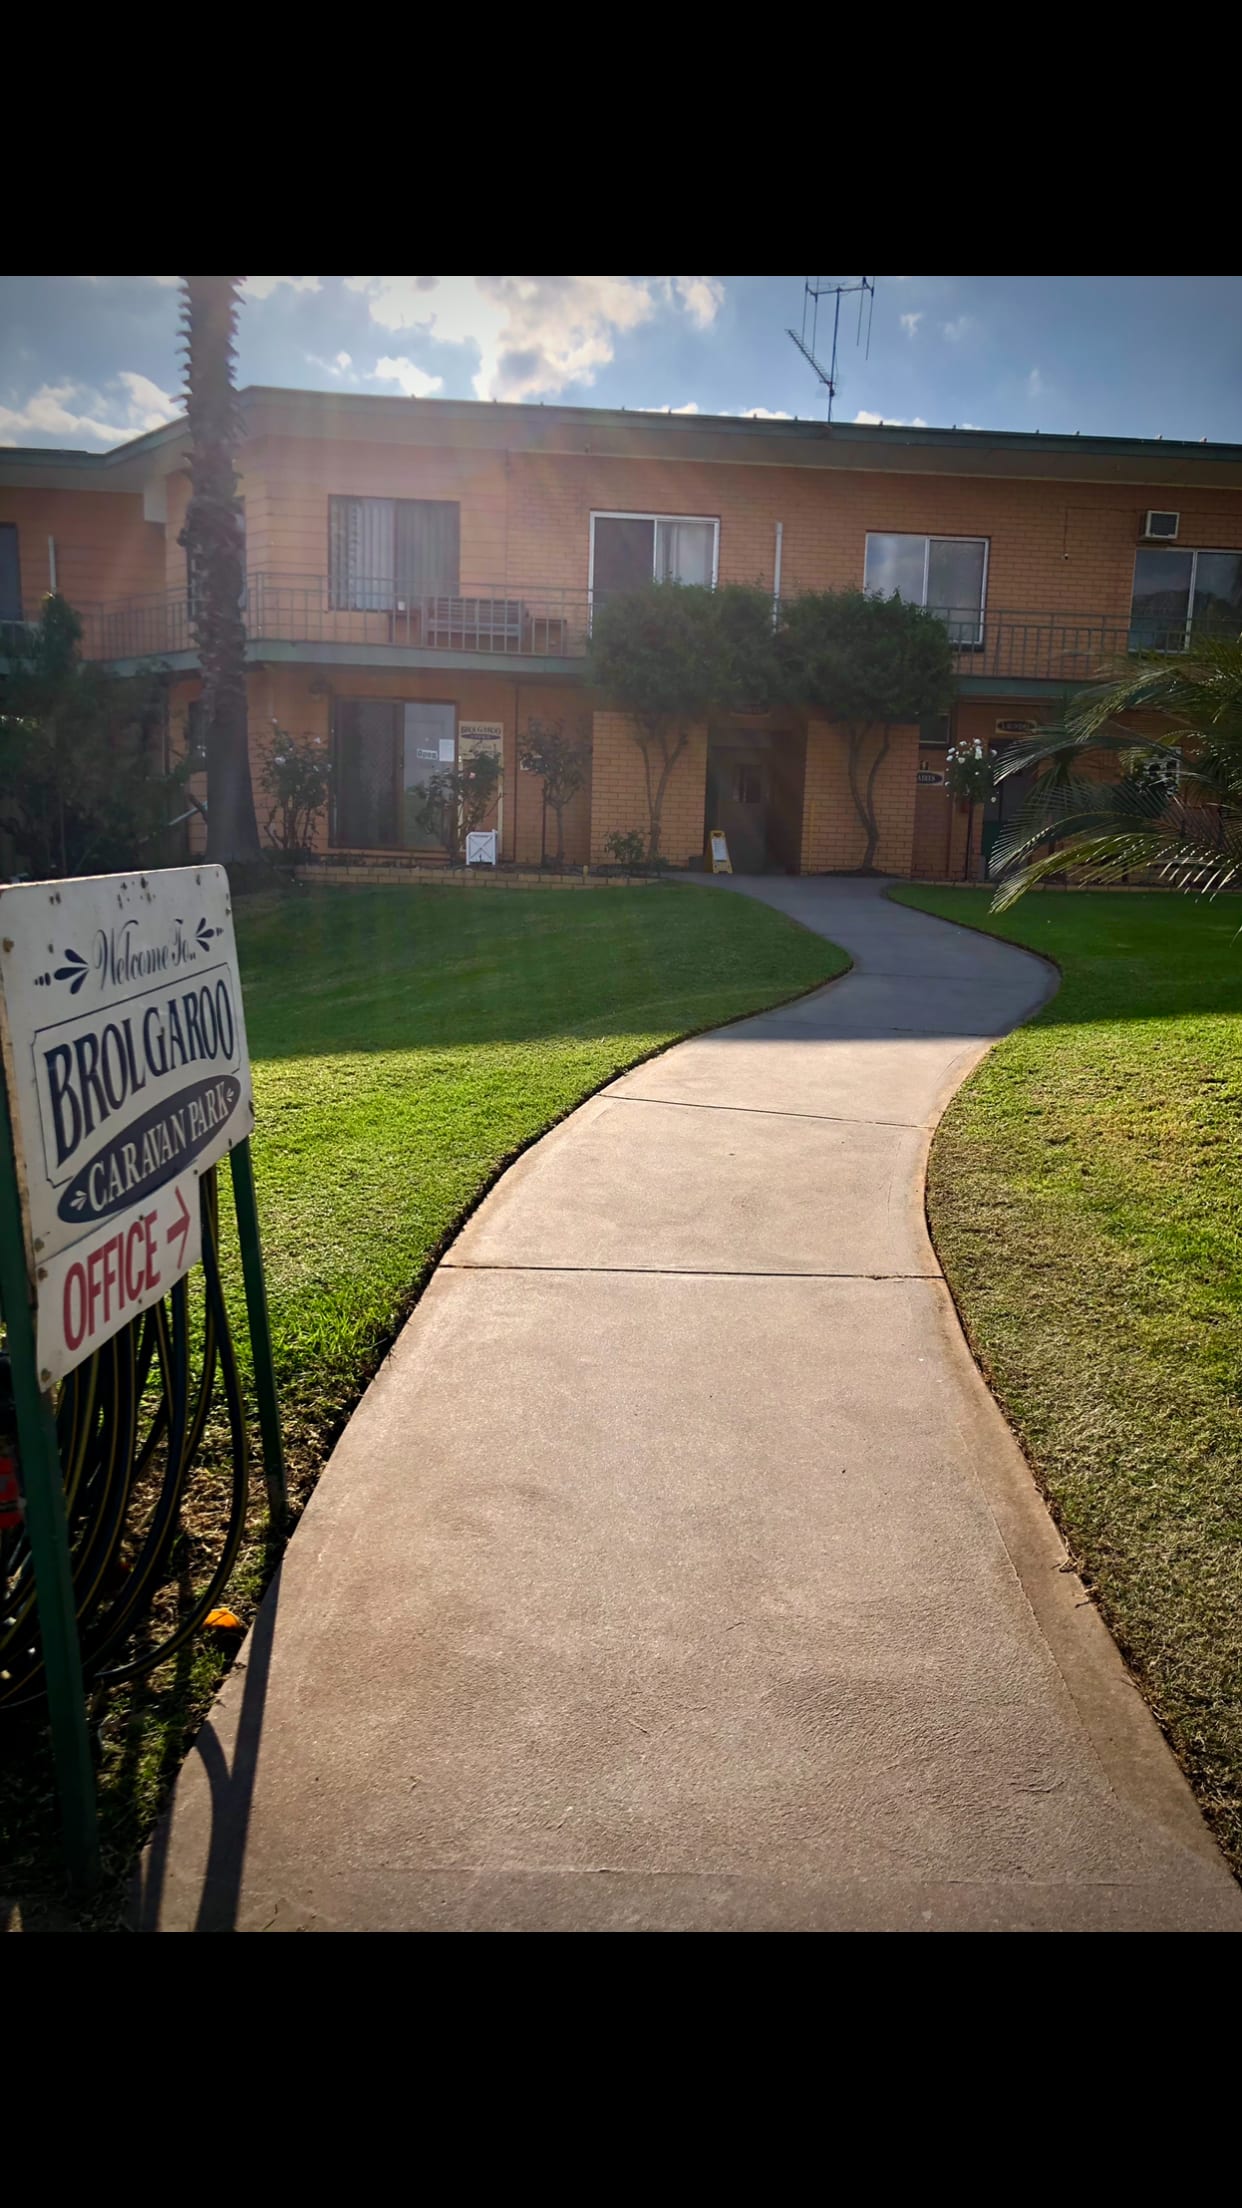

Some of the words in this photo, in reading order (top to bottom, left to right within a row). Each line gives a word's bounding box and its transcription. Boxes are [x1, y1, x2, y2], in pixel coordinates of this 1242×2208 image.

[93, 919, 169, 991] Welcome
[44, 977, 235, 1169] BROLGAROO
[87, 1112, 187, 1212] CARAVAN
[187, 1081, 229, 1156] PARK
[62, 1210, 161, 1352] OFFICE
